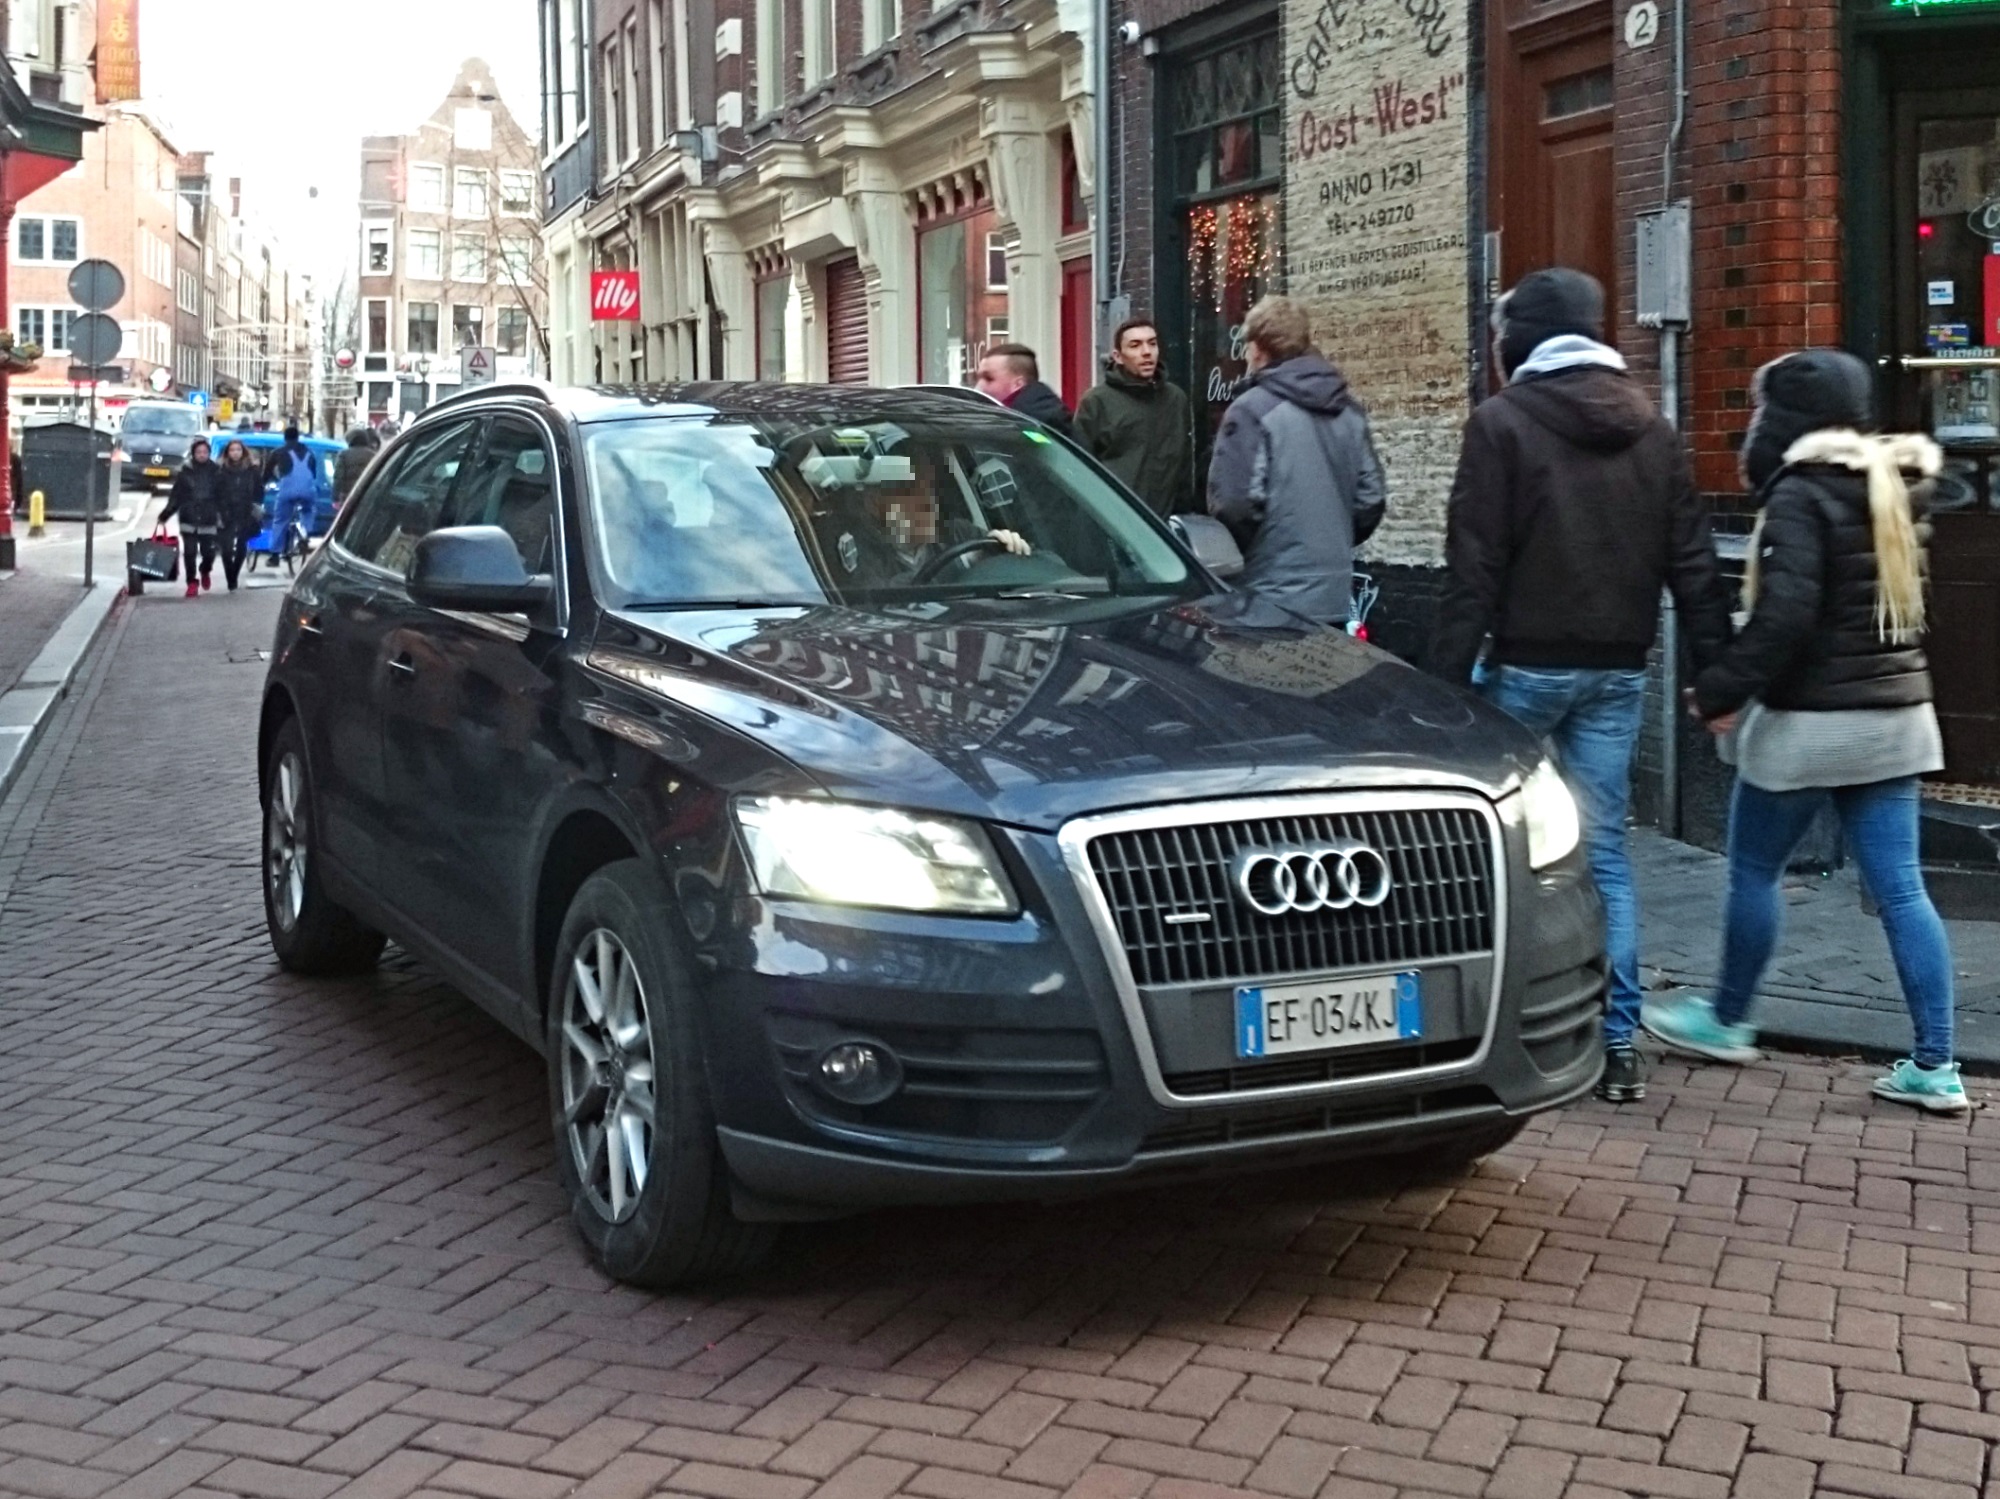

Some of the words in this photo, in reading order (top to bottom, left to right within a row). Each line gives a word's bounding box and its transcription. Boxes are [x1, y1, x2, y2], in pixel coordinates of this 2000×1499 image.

[1635, 8, 1650, 40] 2
[1319, 173, 1372, 204] ANNO
[1382, 159, 1422, 191] 1731
[595, 278, 637, 316] illy
